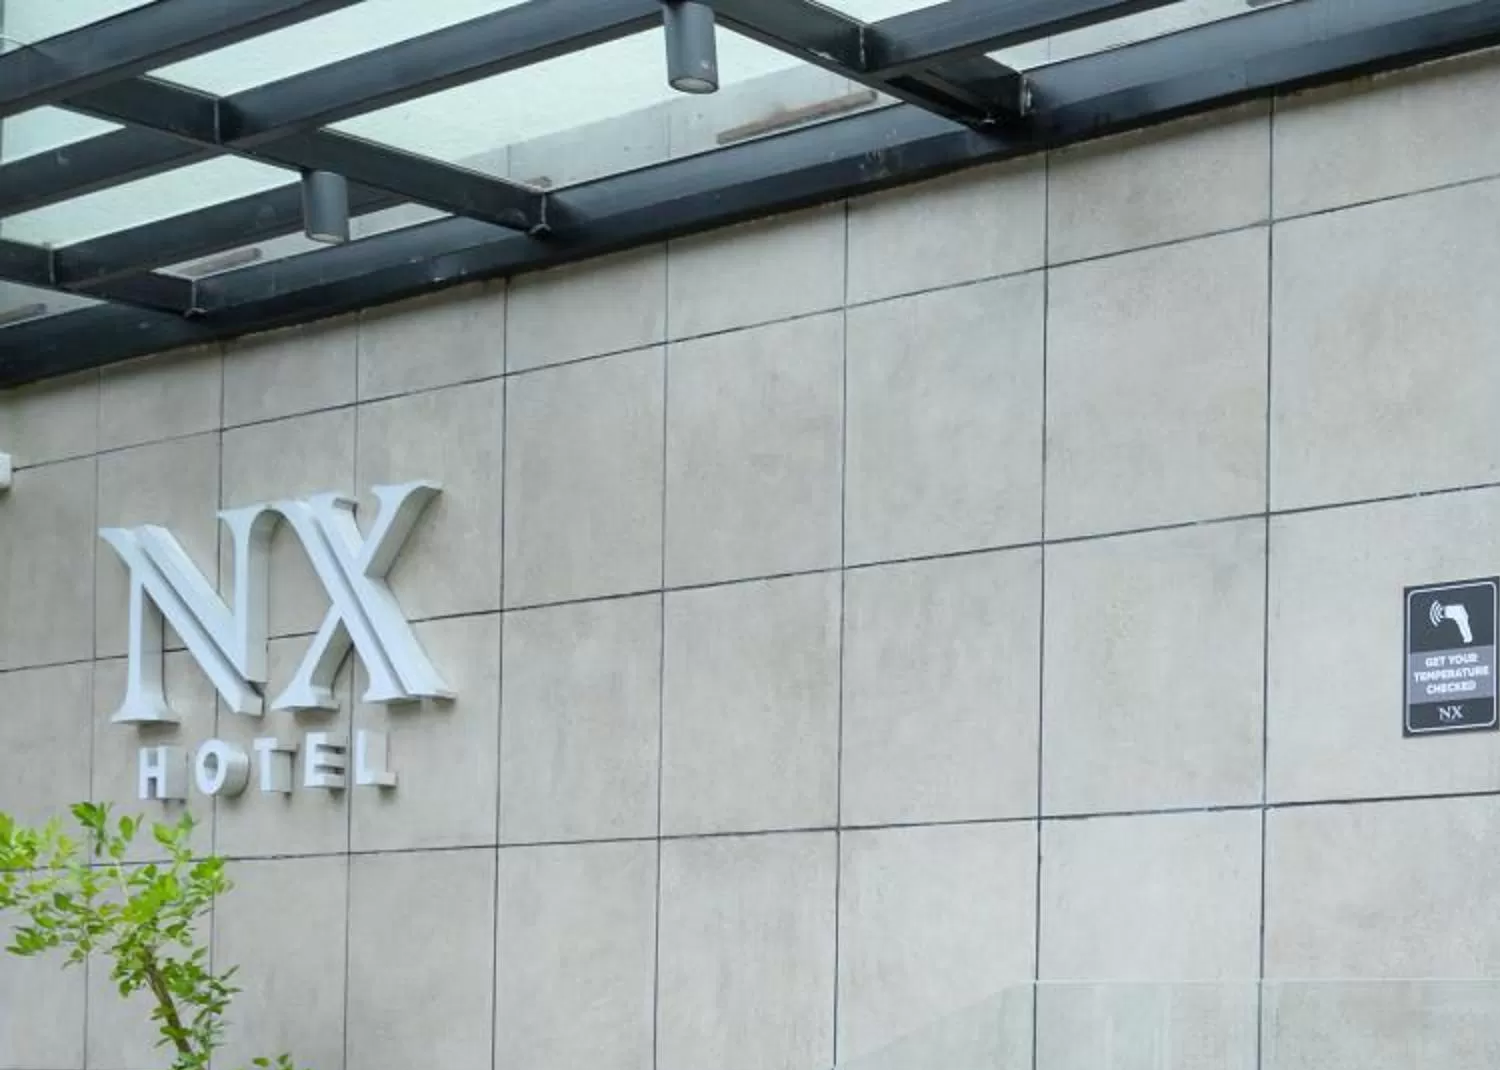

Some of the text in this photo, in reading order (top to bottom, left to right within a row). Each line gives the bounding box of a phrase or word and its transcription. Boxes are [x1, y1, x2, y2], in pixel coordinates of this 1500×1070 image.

[99, 480, 456, 725] NX
[1425, 652, 1477, 668] GET YOUR
[1413, 665, 1489, 682] TEMPERATURE
[1426, 680, 1477, 695] CHECKED
[1438, 704, 1464, 720] NX
[138, 730, 397, 801] HOTEL
